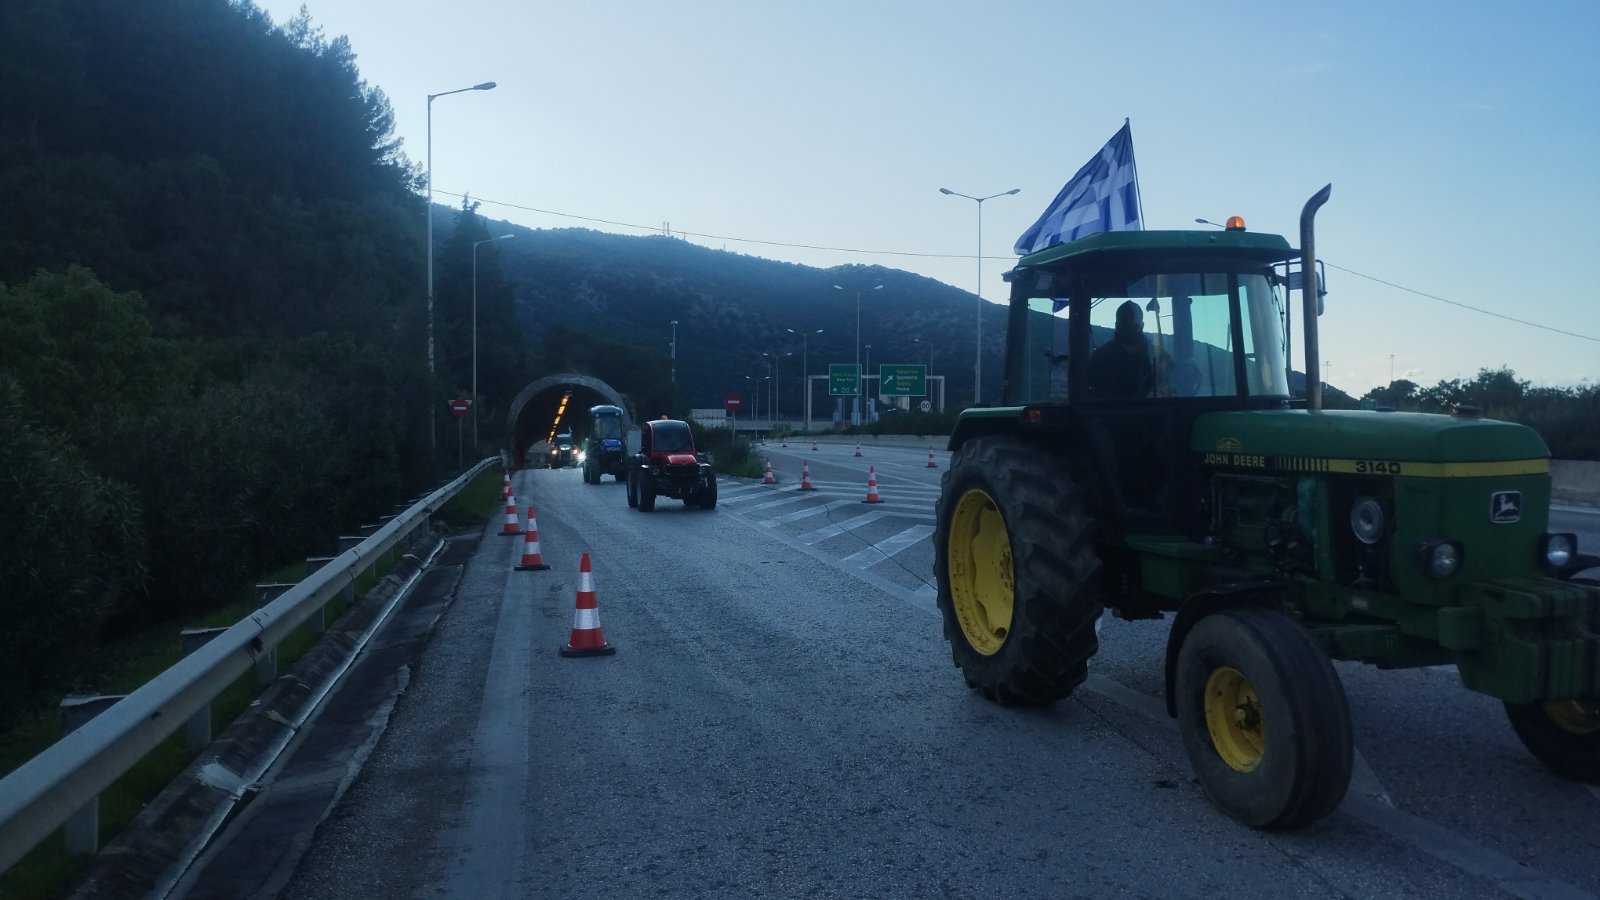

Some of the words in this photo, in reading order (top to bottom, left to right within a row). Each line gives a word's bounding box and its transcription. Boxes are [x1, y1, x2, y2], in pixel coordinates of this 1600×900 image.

[1203, 452, 1229, 465] JOHN
[1233, 454, 1265, 468] DEERE
[1355, 460, 1401, 475] 3140
